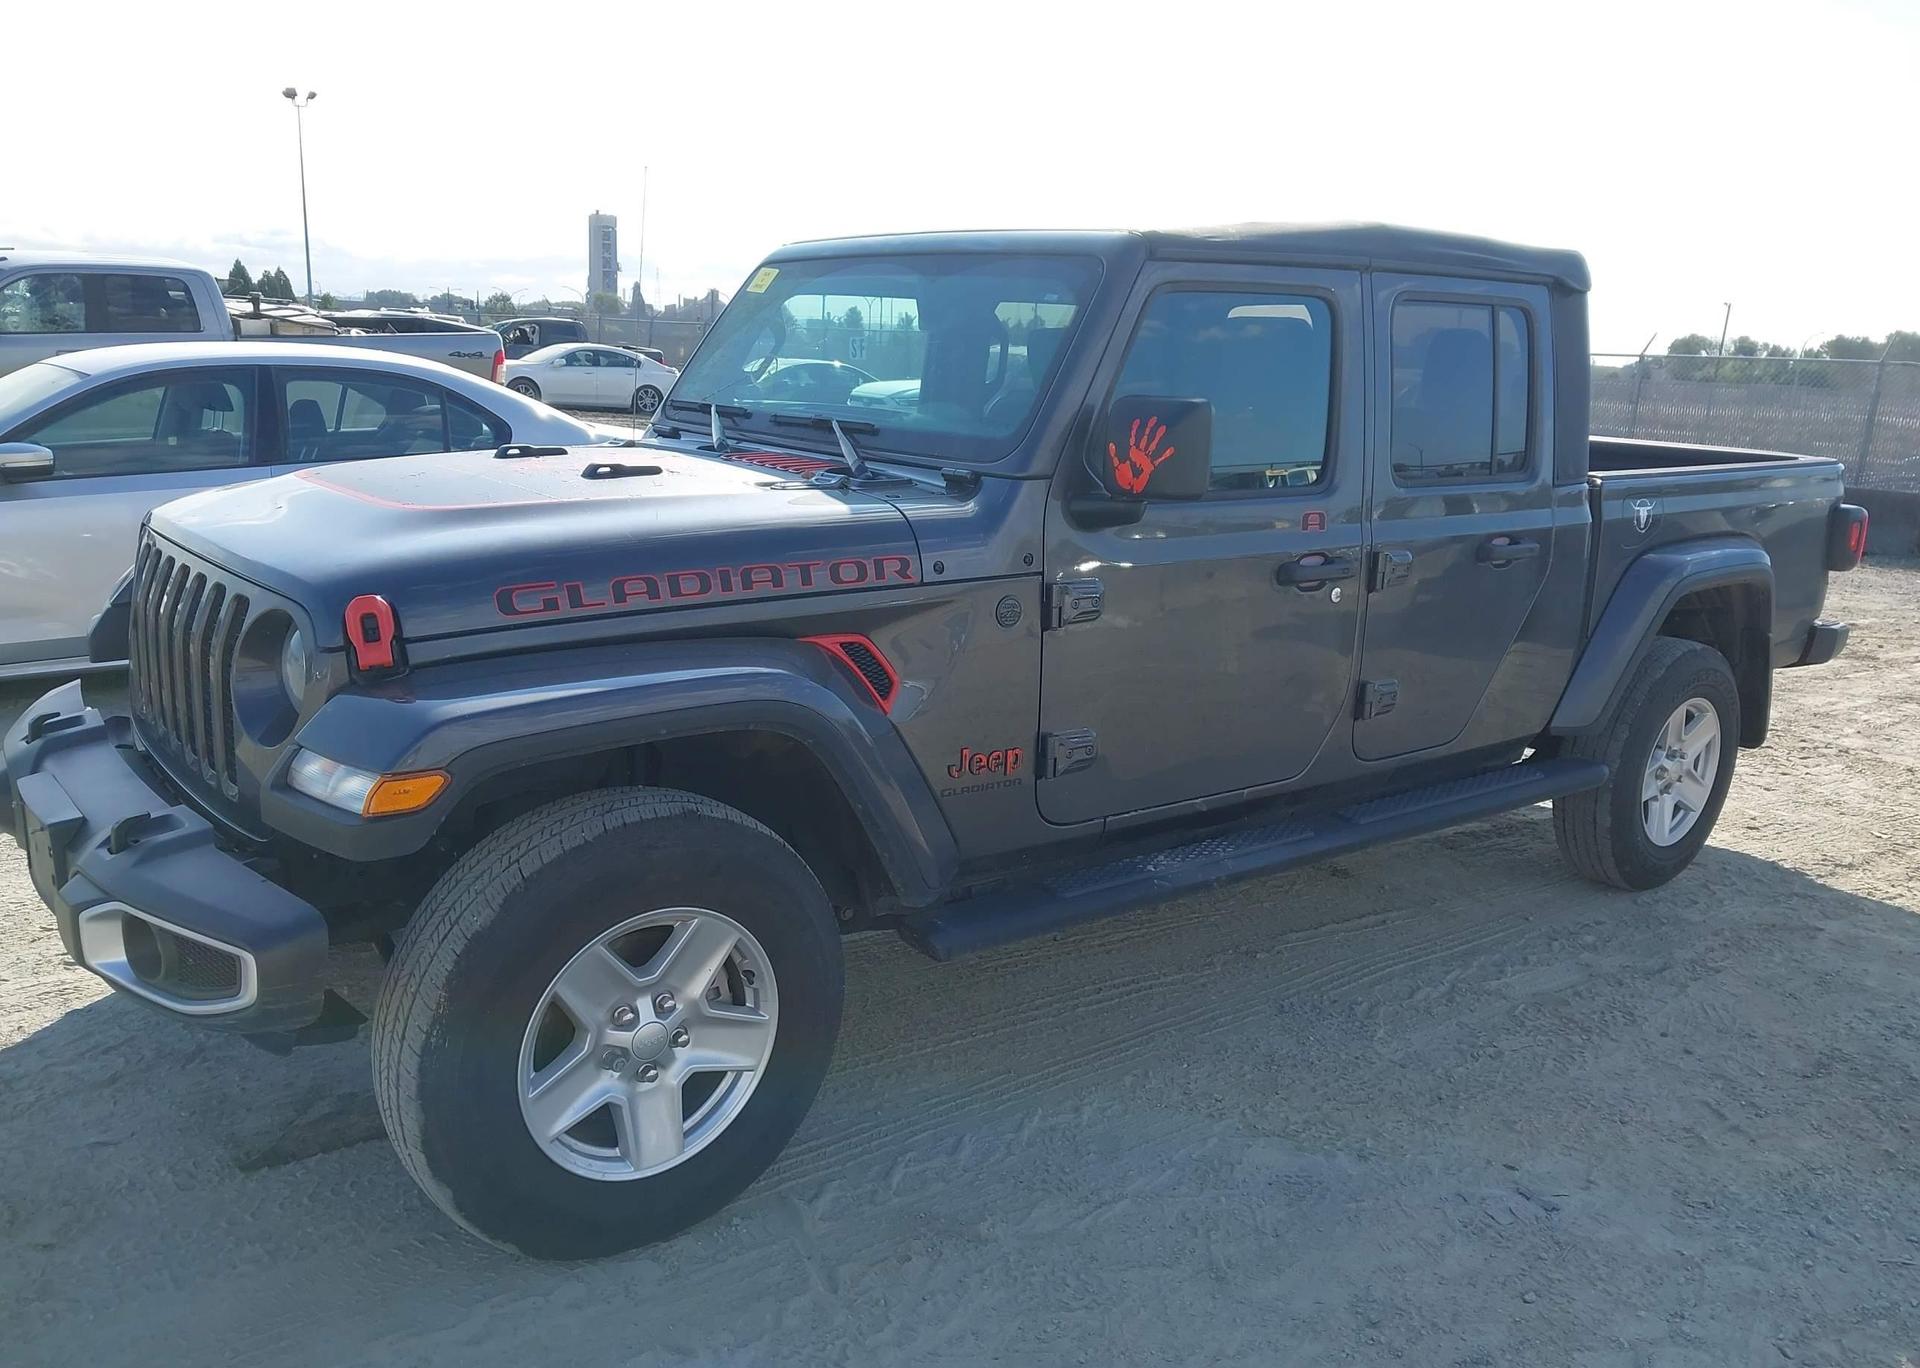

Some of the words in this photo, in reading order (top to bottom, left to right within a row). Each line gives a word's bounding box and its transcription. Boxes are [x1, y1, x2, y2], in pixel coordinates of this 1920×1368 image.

[495, 555, 916, 617] GLADIATOR
[947, 746, 1024, 779] Jeep
[940, 778, 1022, 798] GLADIATOR
